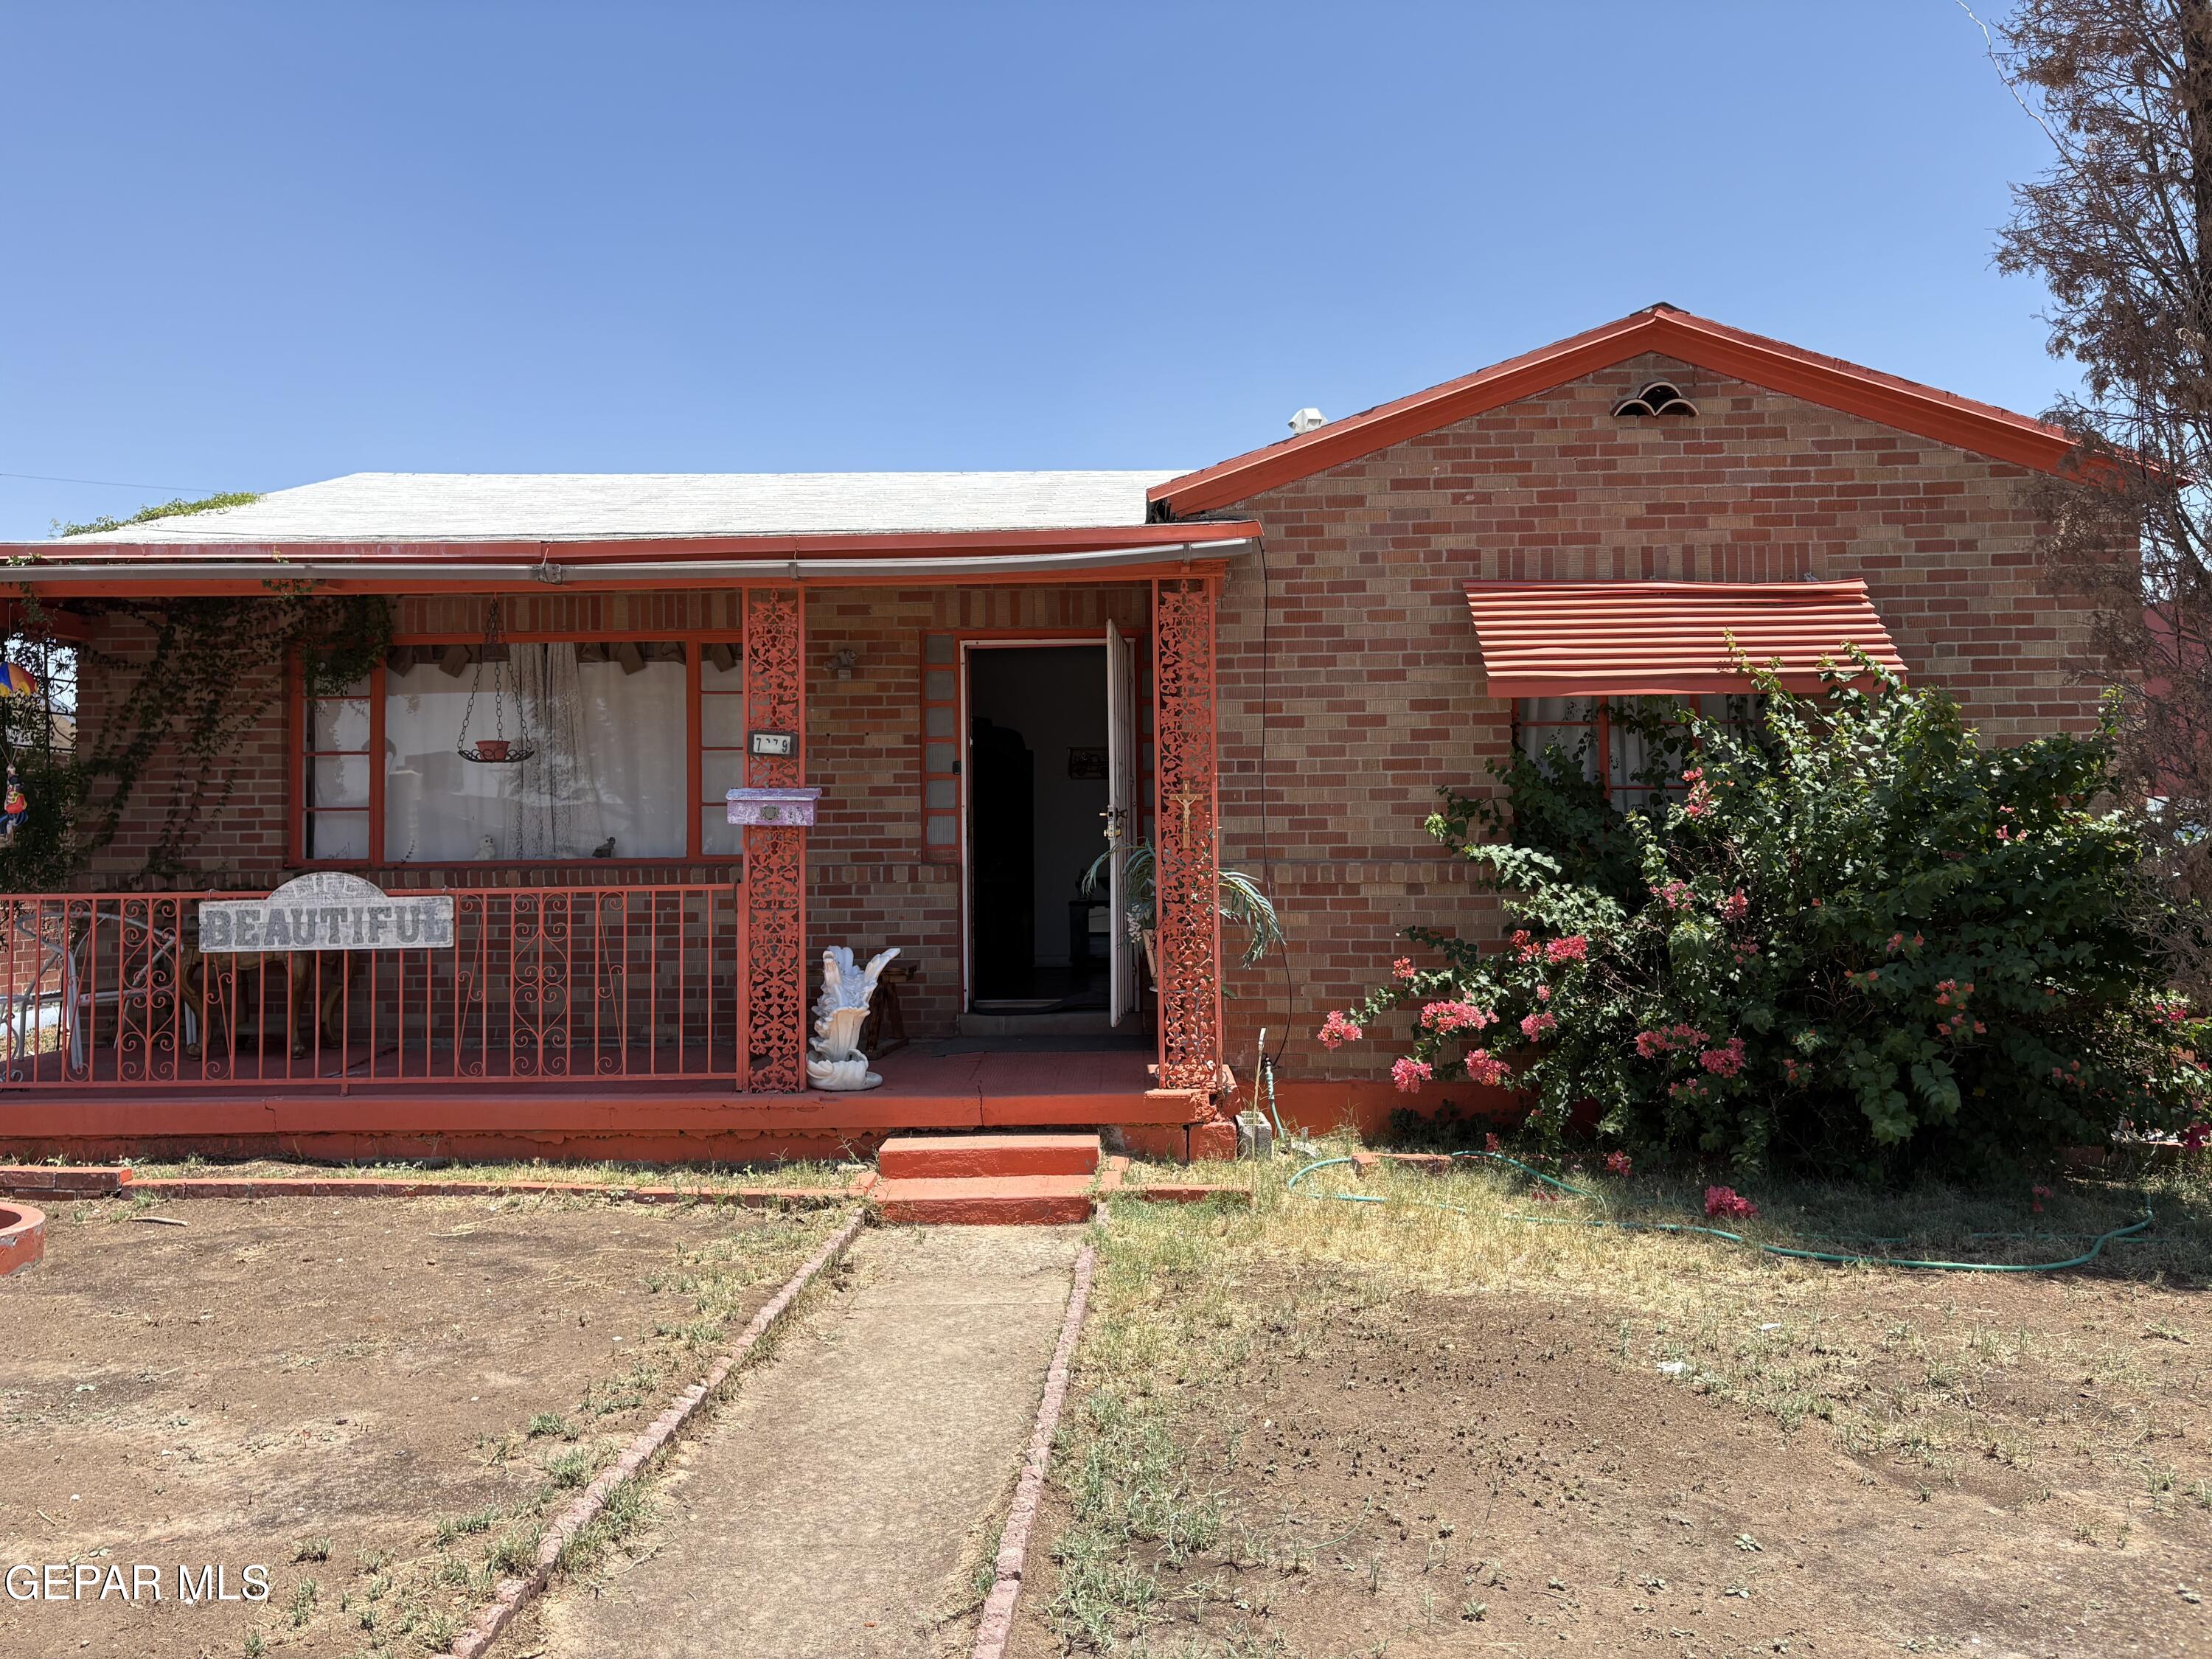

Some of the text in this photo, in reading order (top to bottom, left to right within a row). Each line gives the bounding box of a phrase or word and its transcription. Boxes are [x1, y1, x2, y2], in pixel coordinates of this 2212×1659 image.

[291, 874, 359, 898] LIFE
[322, 894, 335, 904] IS
[204, 904, 449, 947] BEAUTIFUL
